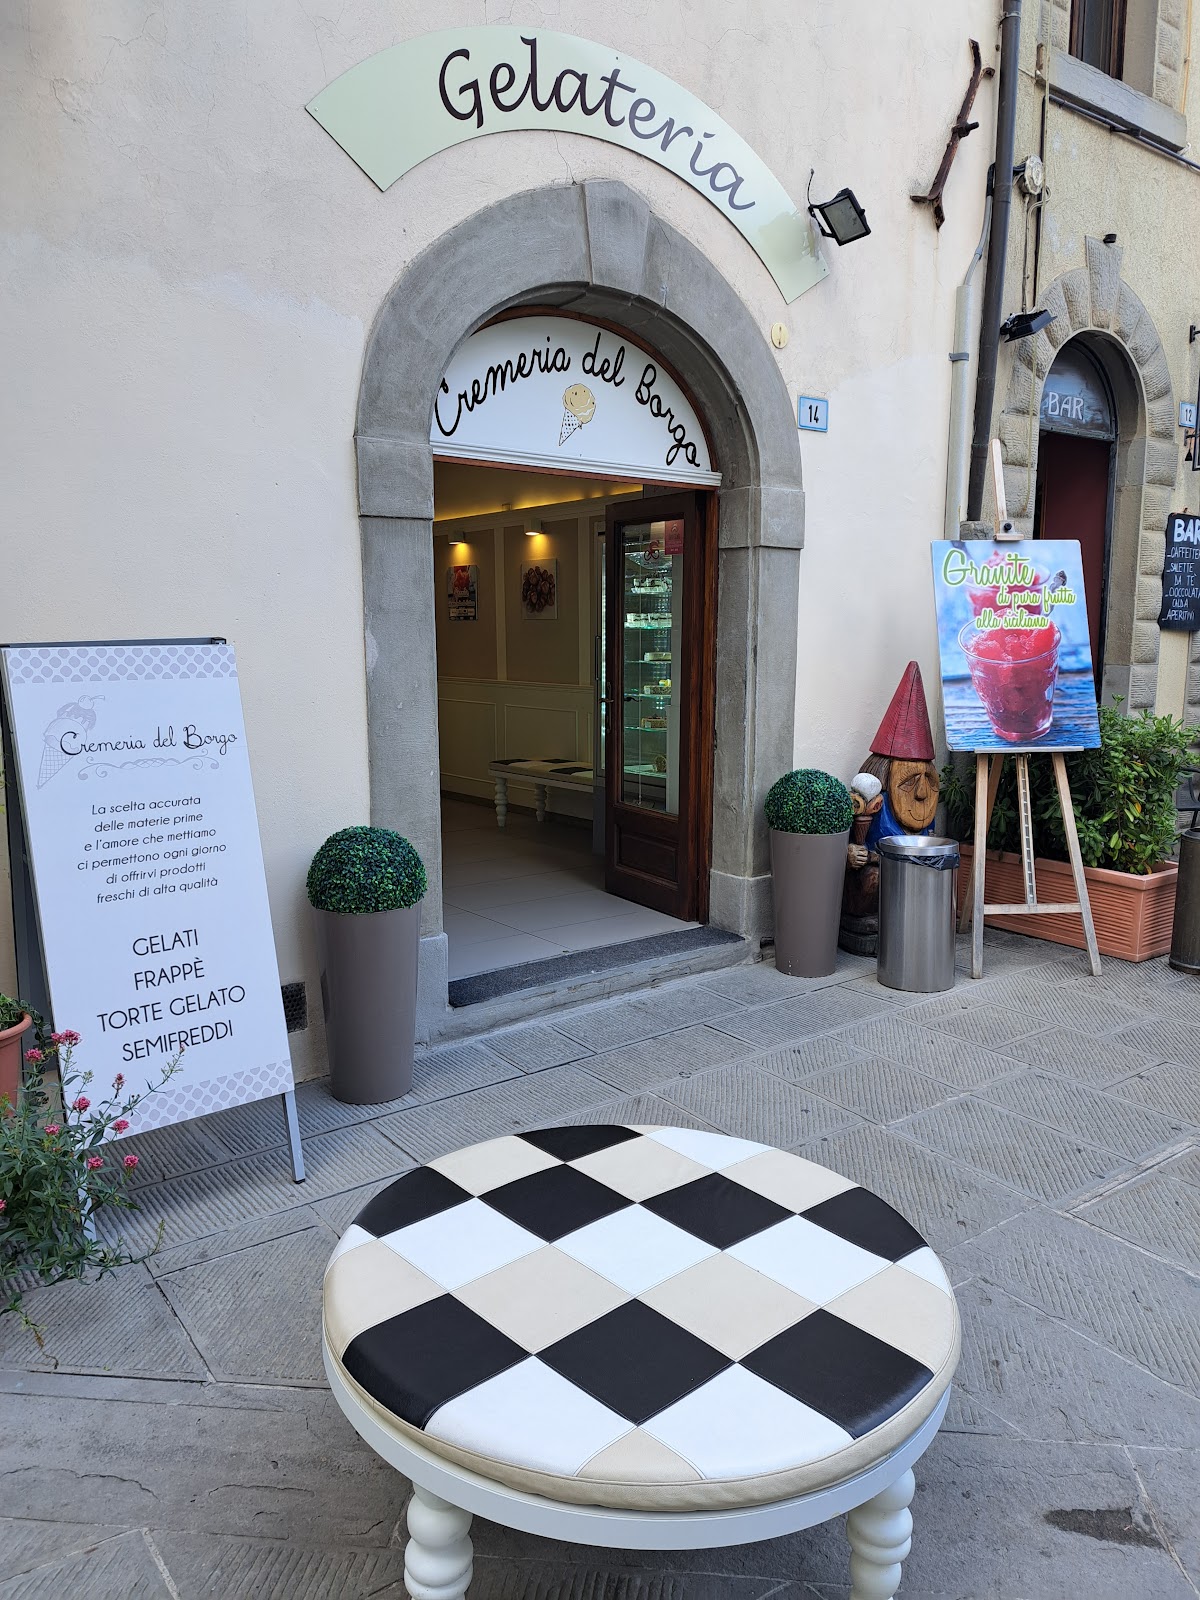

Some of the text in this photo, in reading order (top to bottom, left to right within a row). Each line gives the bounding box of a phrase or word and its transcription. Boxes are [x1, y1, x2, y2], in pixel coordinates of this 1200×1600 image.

[438, 34, 757, 211] Gelateria
[434, 331, 701, 468] Cremeria del Borgo
[1048, 392, 1083, 420] BAR
[809, 405, 819, 423] 14
[1185, 408, 1192, 423] 12
[943, 549, 1034, 586] Granite
[997, 585, 1076, 614] di pura frutta
[976, 609, 1050, 629] alla siciliana
[59, 724, 238, 756] Cremeria del Borgo
[92, 796, 201, 815] La scelta accurata
[94, 813, 203, 833] delle materie prime
[84, 829, 216, 851] e l'amore che mettiamo
[77, 844, 226, 871] ci permettono ogni giorno
[106, 863, 206, 884] di offrirvi prodotti
[97, 877, 218, 904] freschi di alta qualità
[132, 928, 199, 956] GELATI
[133, 957, 205, 990] FRAPPÈ
[97, 985, 246, 1032] TORTE GELATO
[122, 1020, 233, 1061] SEMIFREDDI
